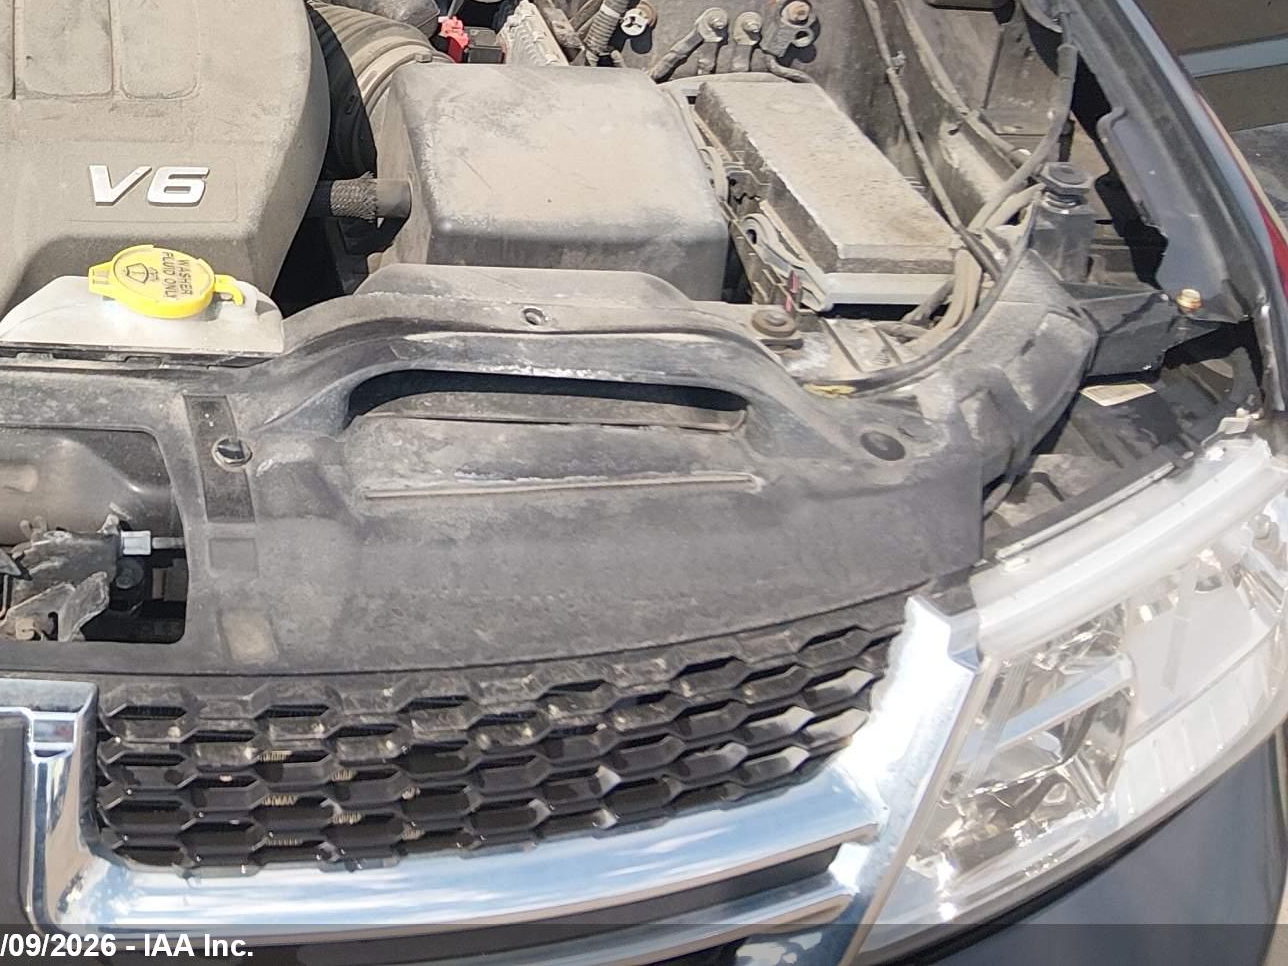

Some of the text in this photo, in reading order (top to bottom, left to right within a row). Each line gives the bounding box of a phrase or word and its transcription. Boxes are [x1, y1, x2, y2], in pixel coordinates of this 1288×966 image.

[89, 164, 210, 207] V6
[162, 251, 176, 277] FLUID
[178, 259, 193, 295] WASHER
